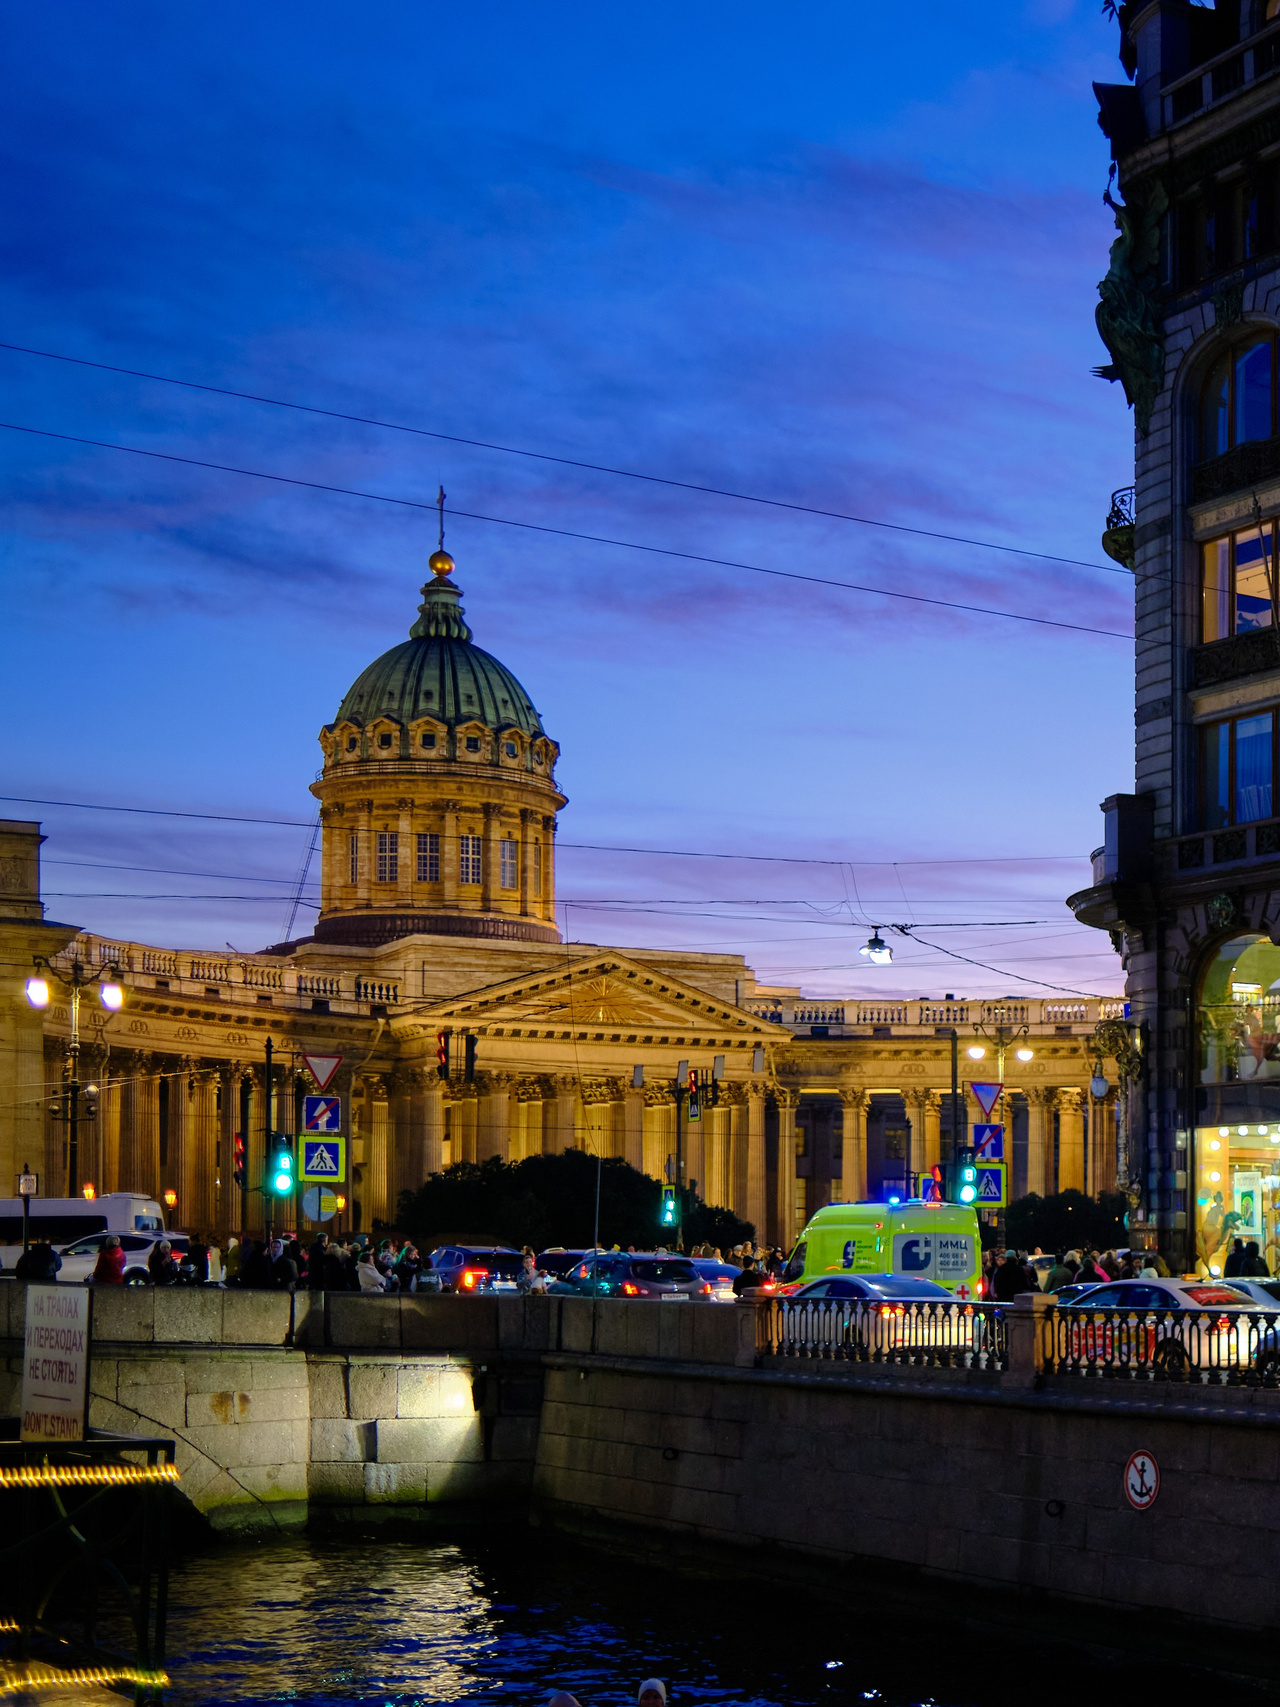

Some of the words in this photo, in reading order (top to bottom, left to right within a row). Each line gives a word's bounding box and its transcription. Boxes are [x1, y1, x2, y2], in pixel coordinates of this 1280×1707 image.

[939, 1239, 968, 1251] ММЦ
[33, 1295, 44, 1317] НА
[46, 1295, 79, 1319] ТРАПАХ
[26, 1326, 33, 1347] И
[34, 1327, 84, 1355] ПЕРЕХОДАХ
[29, 1357, 40, 1380] НЕ
[41, 1358, 78, 1385] СТОЯТЬ!
